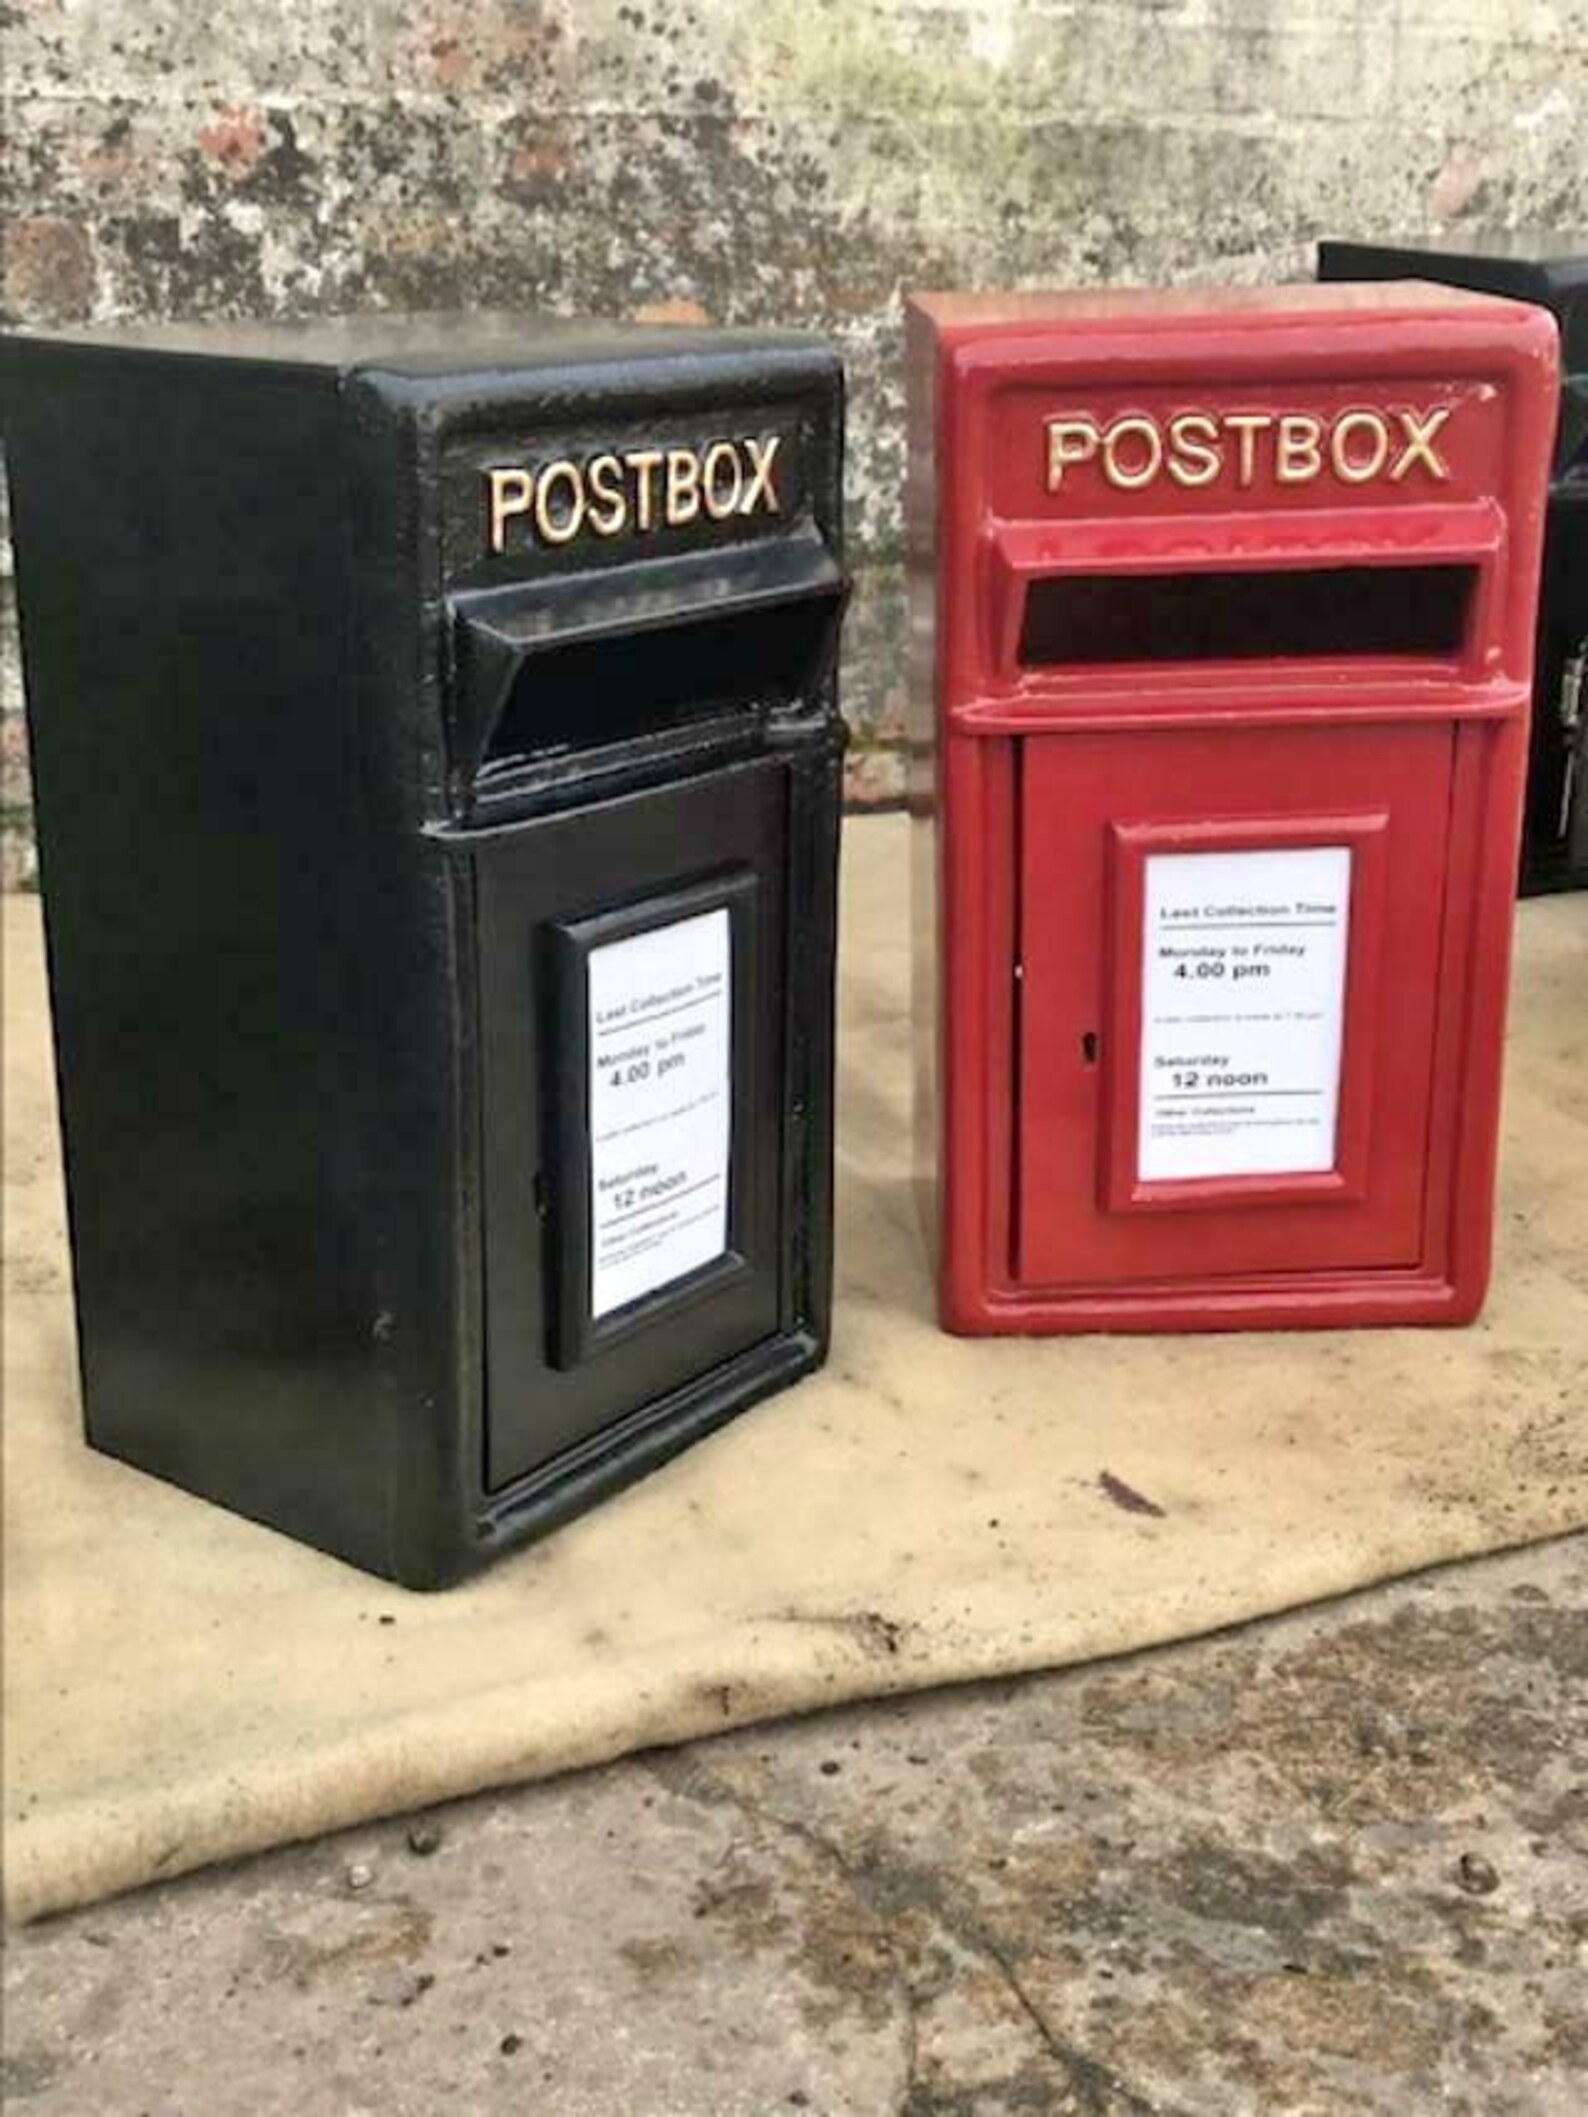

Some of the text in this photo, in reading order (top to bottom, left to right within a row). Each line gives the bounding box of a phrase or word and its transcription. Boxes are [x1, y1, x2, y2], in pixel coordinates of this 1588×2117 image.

[1045, 408, 1451, 490] POSTBOX
[486, 436, 782, 555] POSTBOX
[1160, 906, 1199, 920] Last
[1203, 903, 1291, 918] Collection
[1158, 946, 1227, 959] Monday
[1253, 944, 1306, 958] Friday
[1173, 961, 1271, 981] 4.00 pm
[608, 1052, 687, 1088] 4.00 pm
[1153, 1055, 1231, 1069] Saturday
[1171, 1070, 1269, 1089] 12 noon
[613, 1169, 688, 1211] 12 noon
